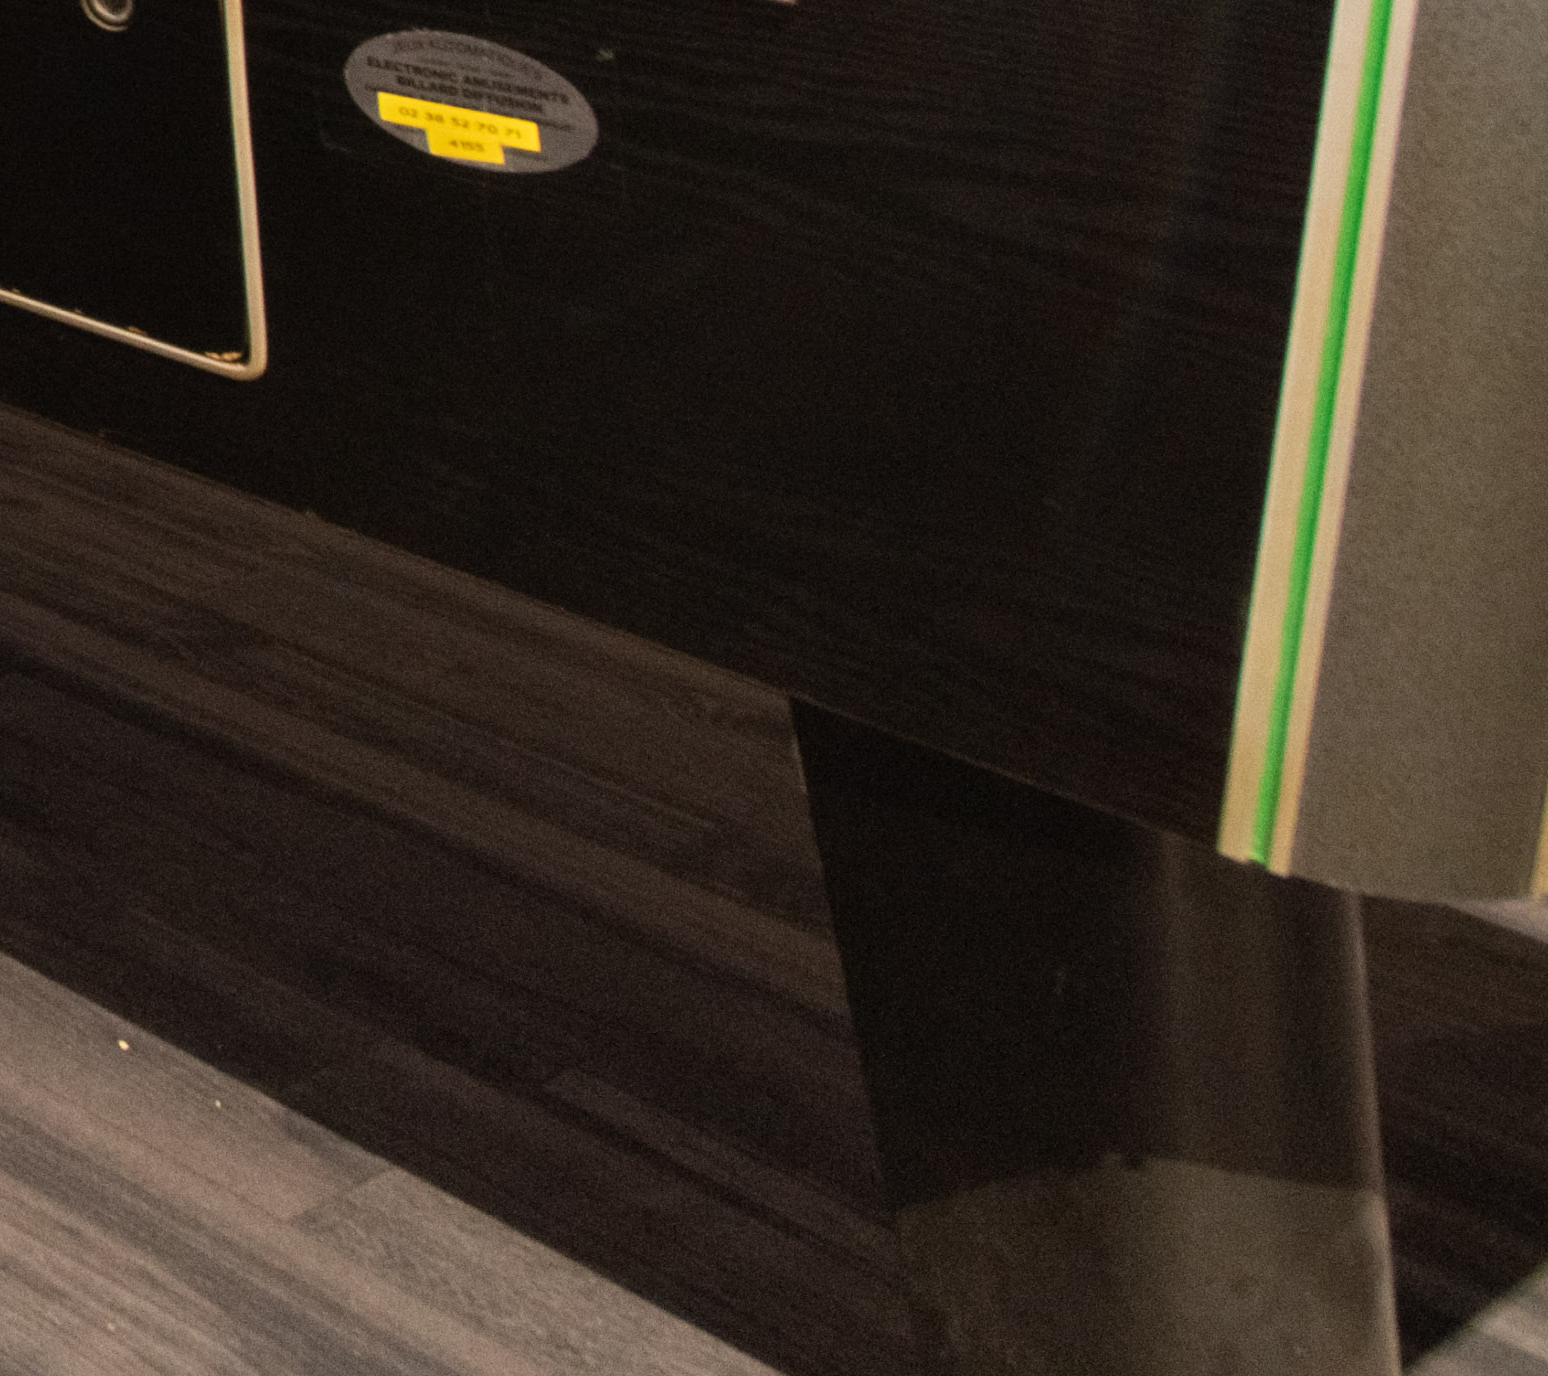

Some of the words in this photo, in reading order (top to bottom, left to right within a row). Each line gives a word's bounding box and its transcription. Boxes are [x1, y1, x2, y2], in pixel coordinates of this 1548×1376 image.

[399, 106, 418, 119] 02
[425, 111, 444, 124] 38
[451, 116, 469, 129] 52
[477, 122, 498, 135] 70
